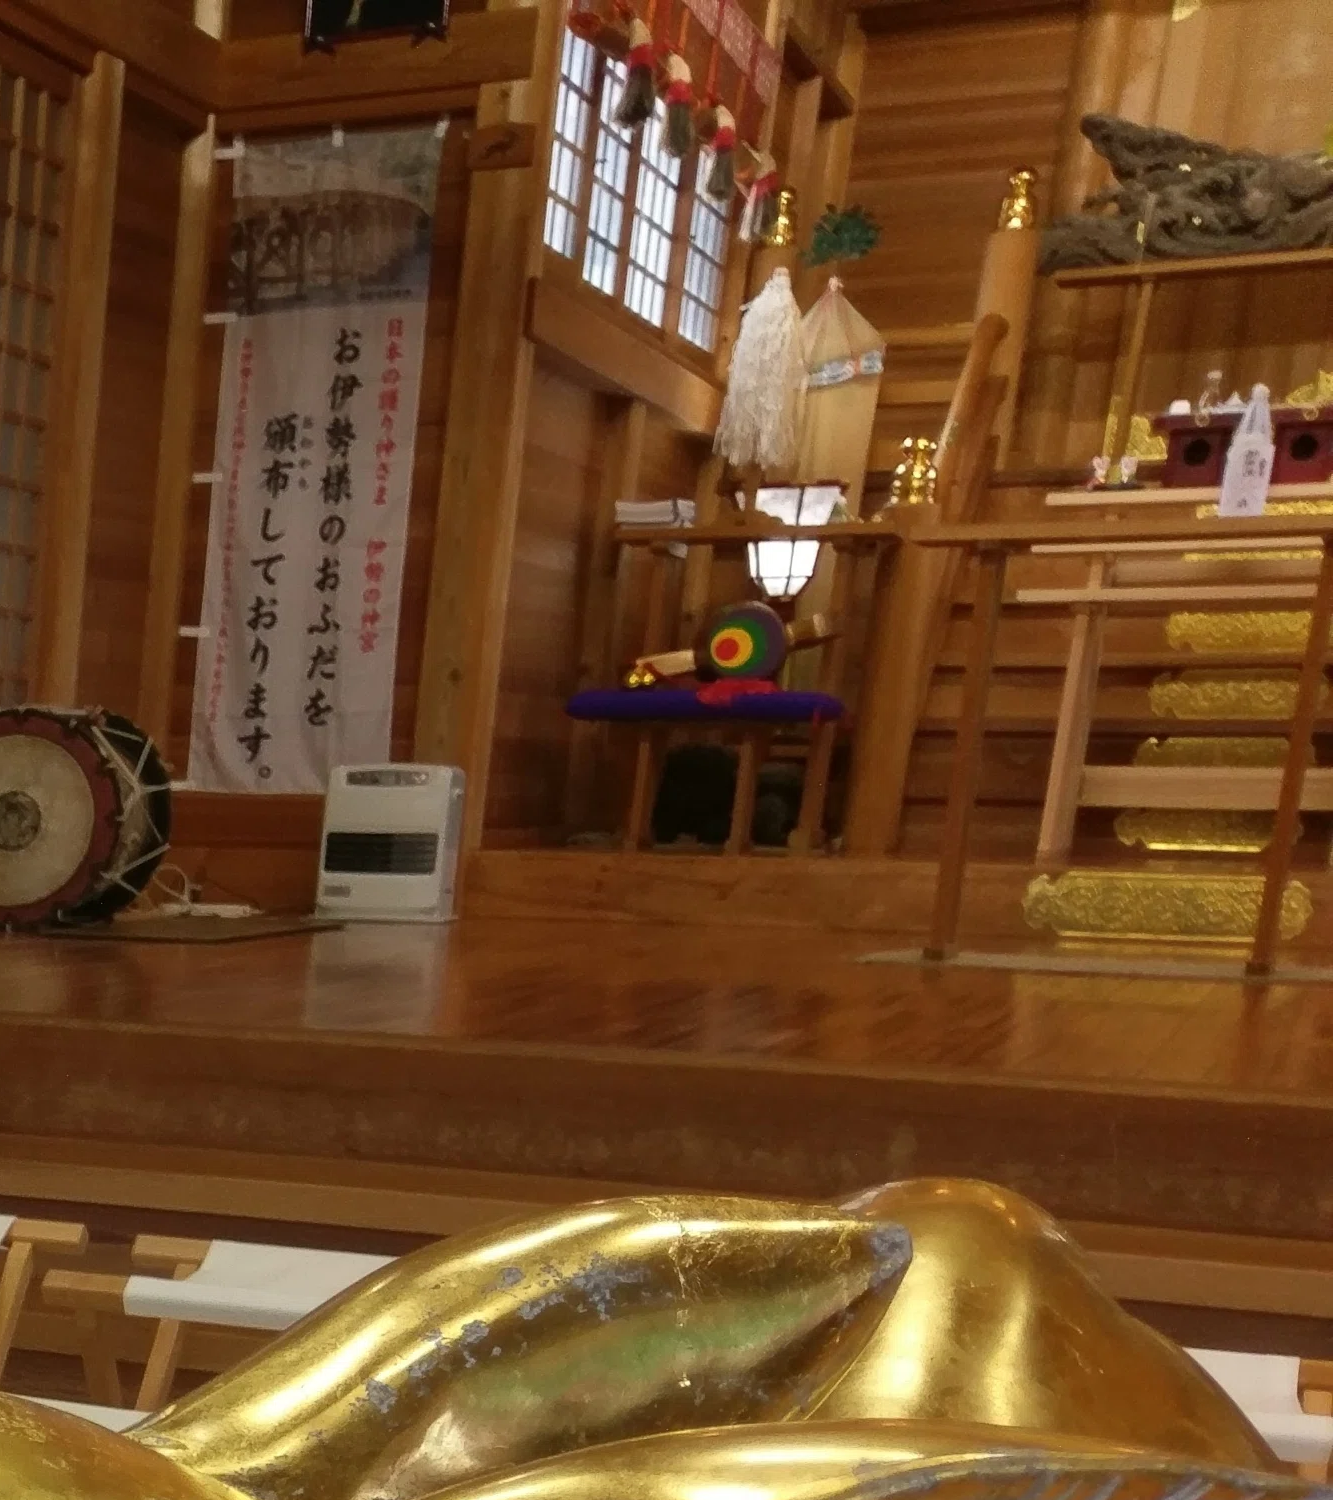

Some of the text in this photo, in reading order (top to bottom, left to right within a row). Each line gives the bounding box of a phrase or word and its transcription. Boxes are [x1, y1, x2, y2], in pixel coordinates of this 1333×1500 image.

[303, 327, 363, 727] お伊勢様のおふだを
